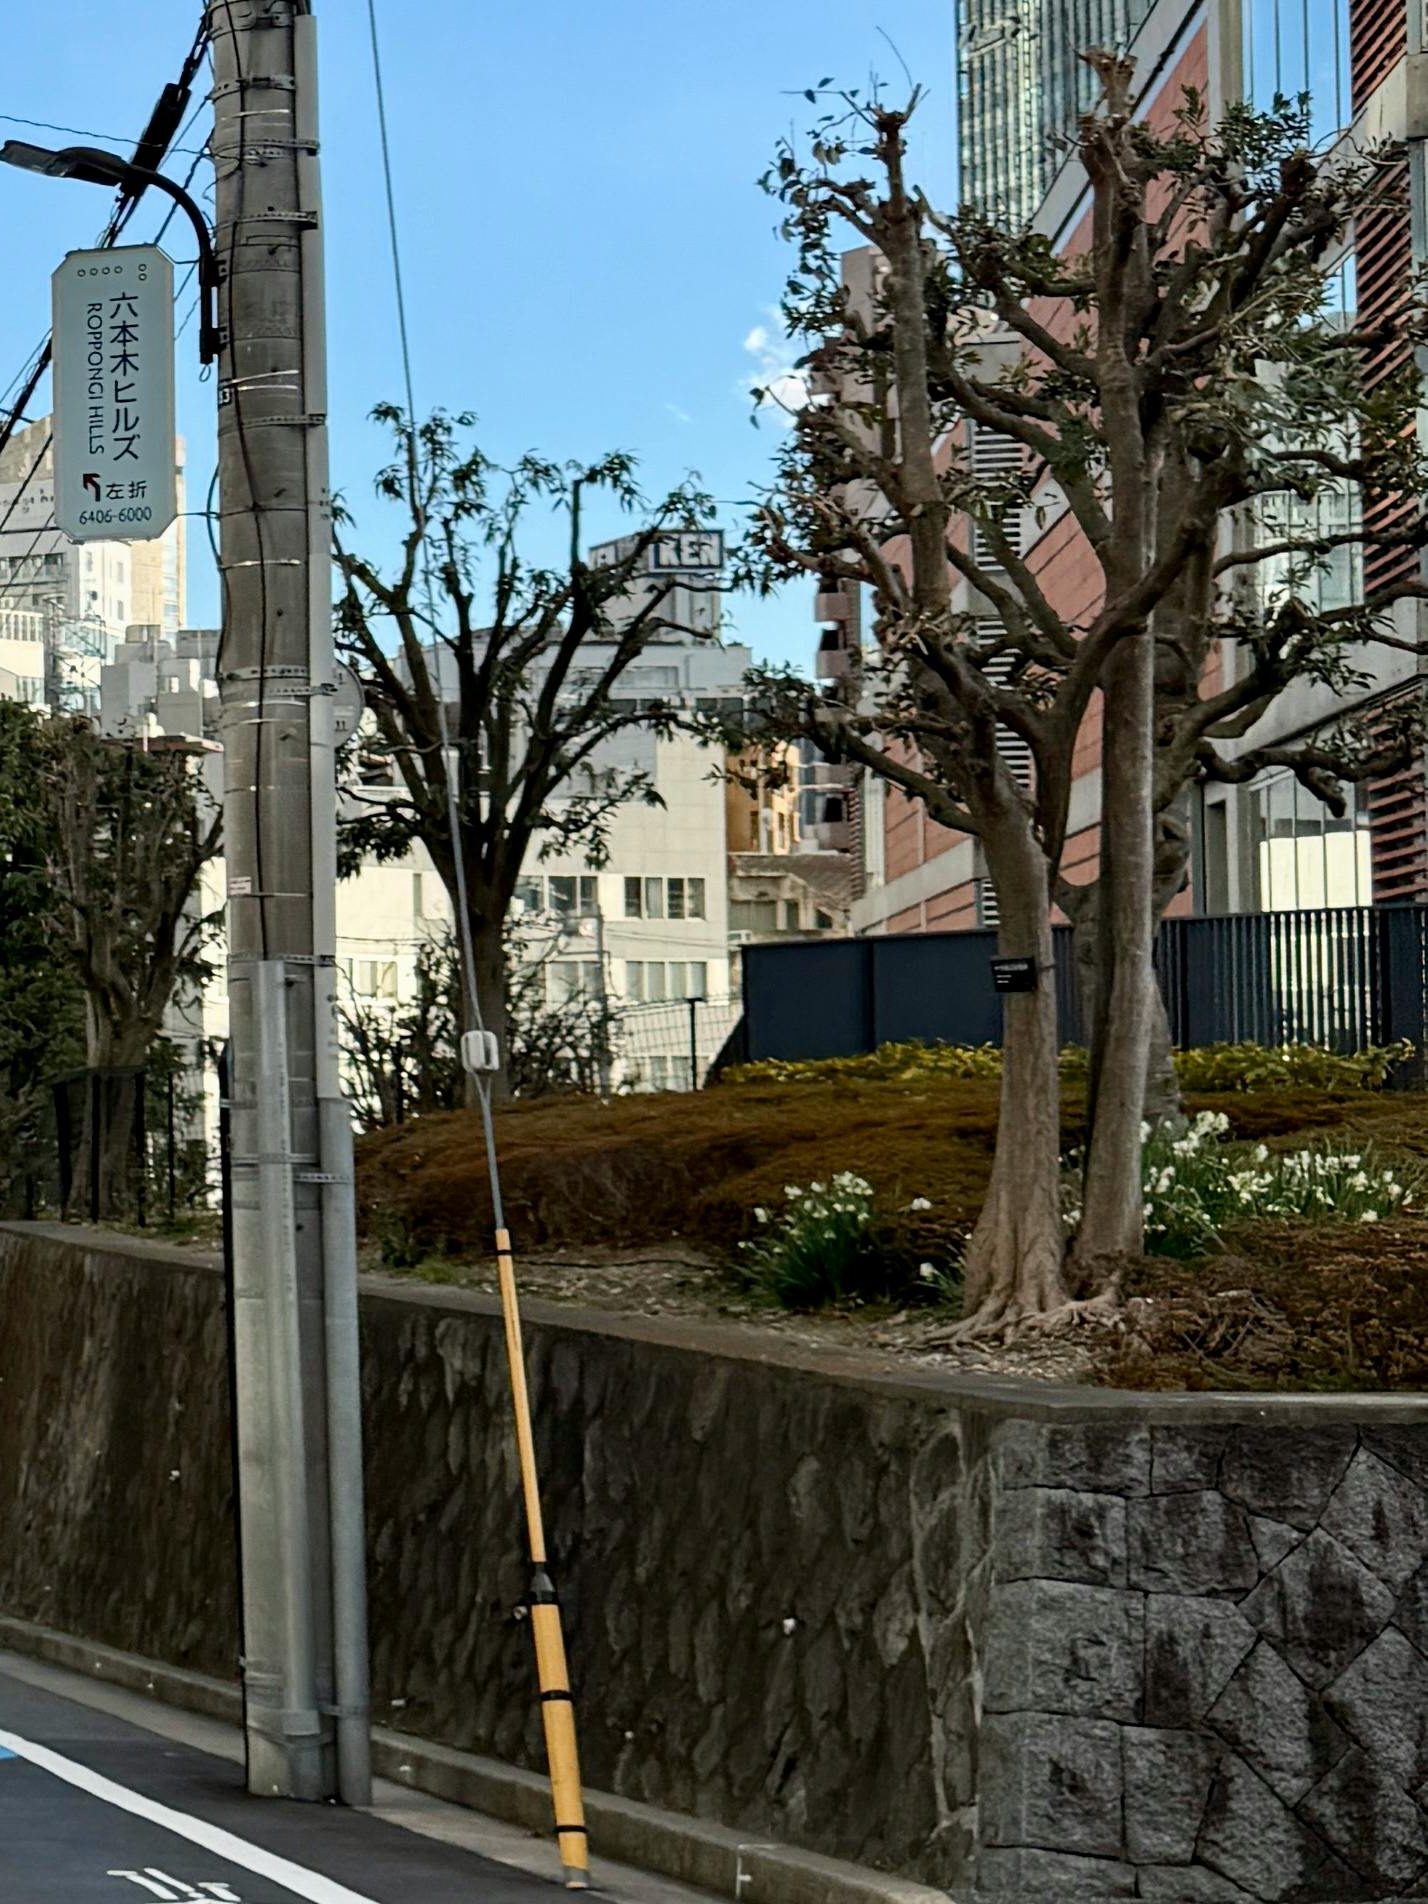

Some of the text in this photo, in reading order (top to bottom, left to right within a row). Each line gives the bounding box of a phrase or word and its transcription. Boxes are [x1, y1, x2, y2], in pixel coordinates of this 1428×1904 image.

[87, 302, 105, 455] ROPPONGI HILLS
[109, 291, 141, 461] 六本木ヒルズ
[79, 506, 152, 525] 6406-6000
[105, 480, 147, 500] 左折
